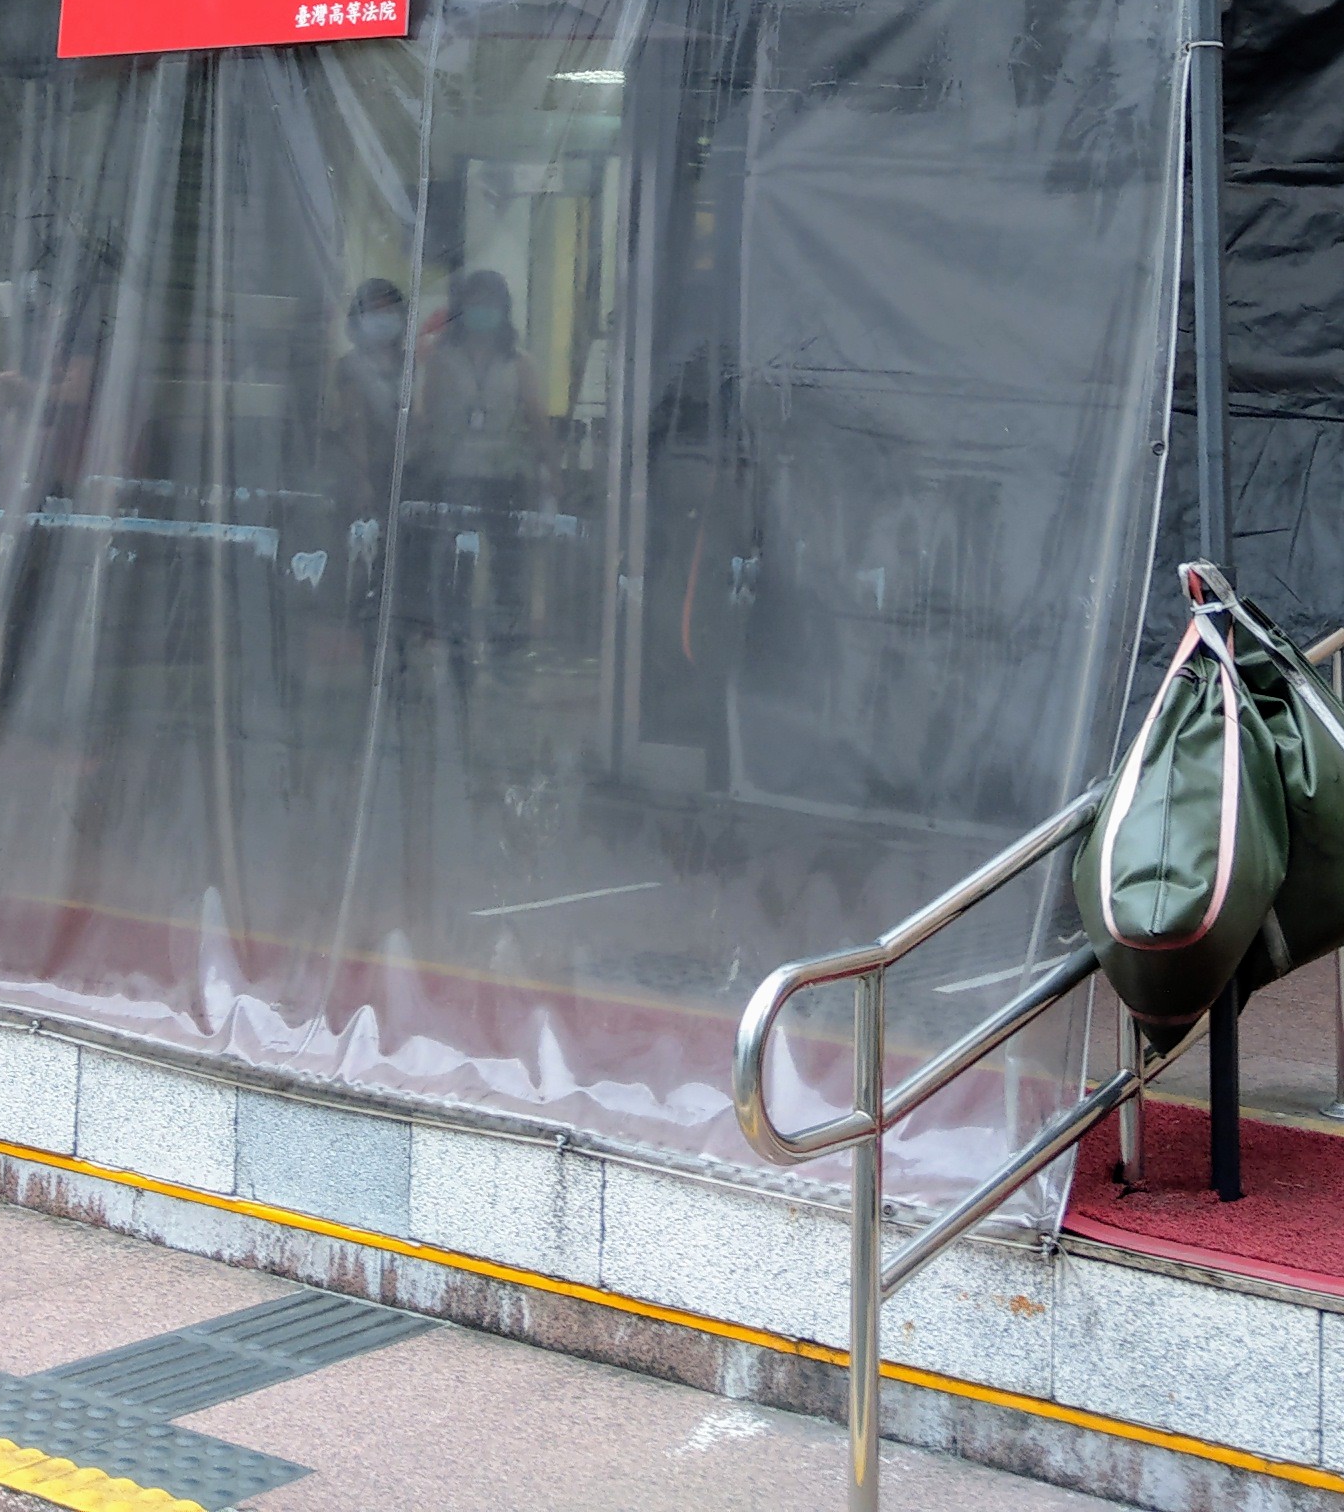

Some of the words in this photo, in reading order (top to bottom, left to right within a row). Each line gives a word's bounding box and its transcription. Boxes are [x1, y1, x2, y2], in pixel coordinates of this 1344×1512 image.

[294, 0, 398, 28] 臺灣高等法院
